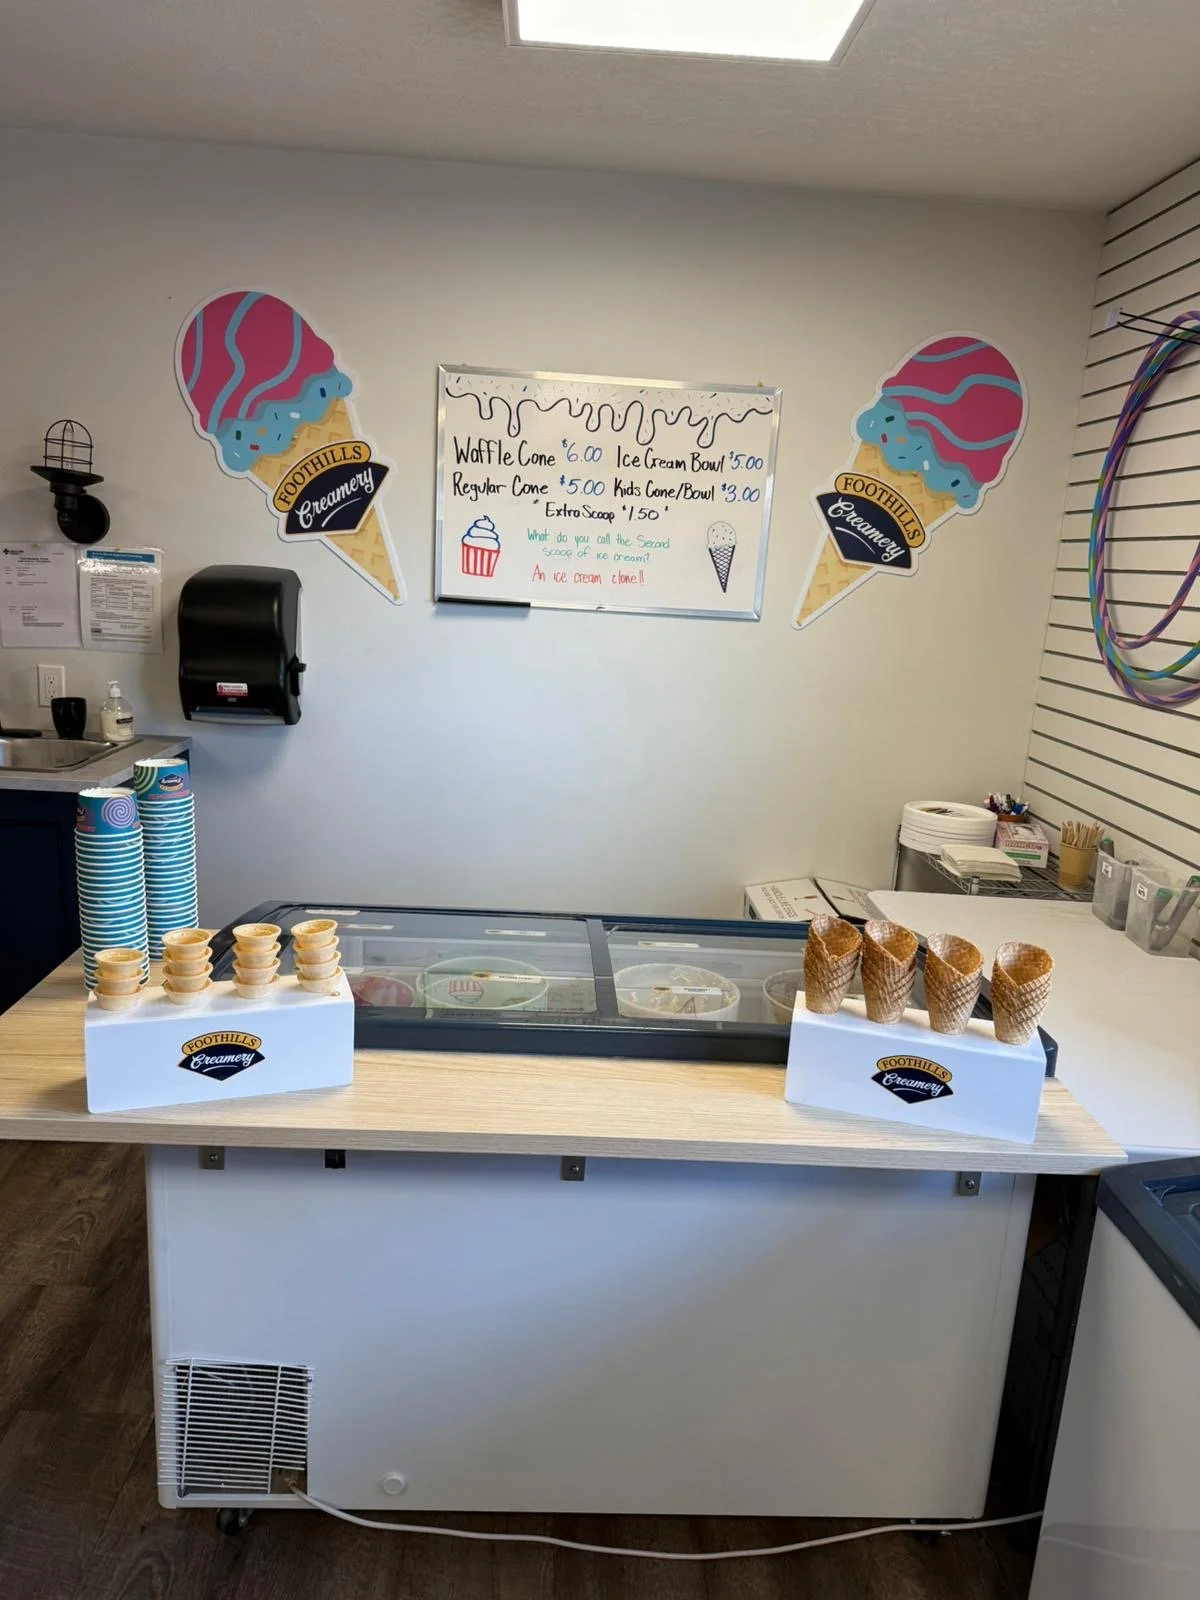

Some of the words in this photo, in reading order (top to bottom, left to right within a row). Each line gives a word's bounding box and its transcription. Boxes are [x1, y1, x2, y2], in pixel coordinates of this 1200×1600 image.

[453, 436, 515, 466] Waffle
[518, 440, 556, 467] Cone
[562, 438, 603, 463] $6.00
[617, 445, 641, 468] Ice
[644, 447, 687, 471] Cream
[690, 452, 725, 473] Bowl
[728, 451, 764, 470] $5.00
[278, 445, 362, 507] FOOTHILLS
[452, 471, 507, 501] Regular
[511, 474, 549, 497] Cone
[559, 474, 605, 496] $5.00
[294, 467, 375, 529] Creamery
[613, 477, 642, 498] Kids
[645, 479, 715, 501] Cone/Bowl
[721, 482, 760, 503] $3.00
[545, 501, 581, 518] Extra
[582, 504, 615, 524] Scoop
[843, 477, 921, 541] FOOTHILLS
[527, 528, 548, 542] What
[556, 531, 567, 543] do
[574, 534, 589, 548] you
[596, 533, 611, 545] call
[615, 533, 632, 546] the
[827, 496, 905, 562] Creamery
[576, 545, 591, 558] of
[596, 551, 609, 560] ice
[613, 552, 650, 564] cream?
[532, 564, 546, 583] An
[553, 570, 567, 583] ice
[573, 573, 602, 584] cream
[611, 569, 645, 587] clone!!
[186, 1033, 257, 1053] FOOTHILLS
[190, 1052, 255, 1070] Creamery
[881, 1057, 949, 1079] FOOTHILLS
[882, 1072, 945, 1097] Creamery
